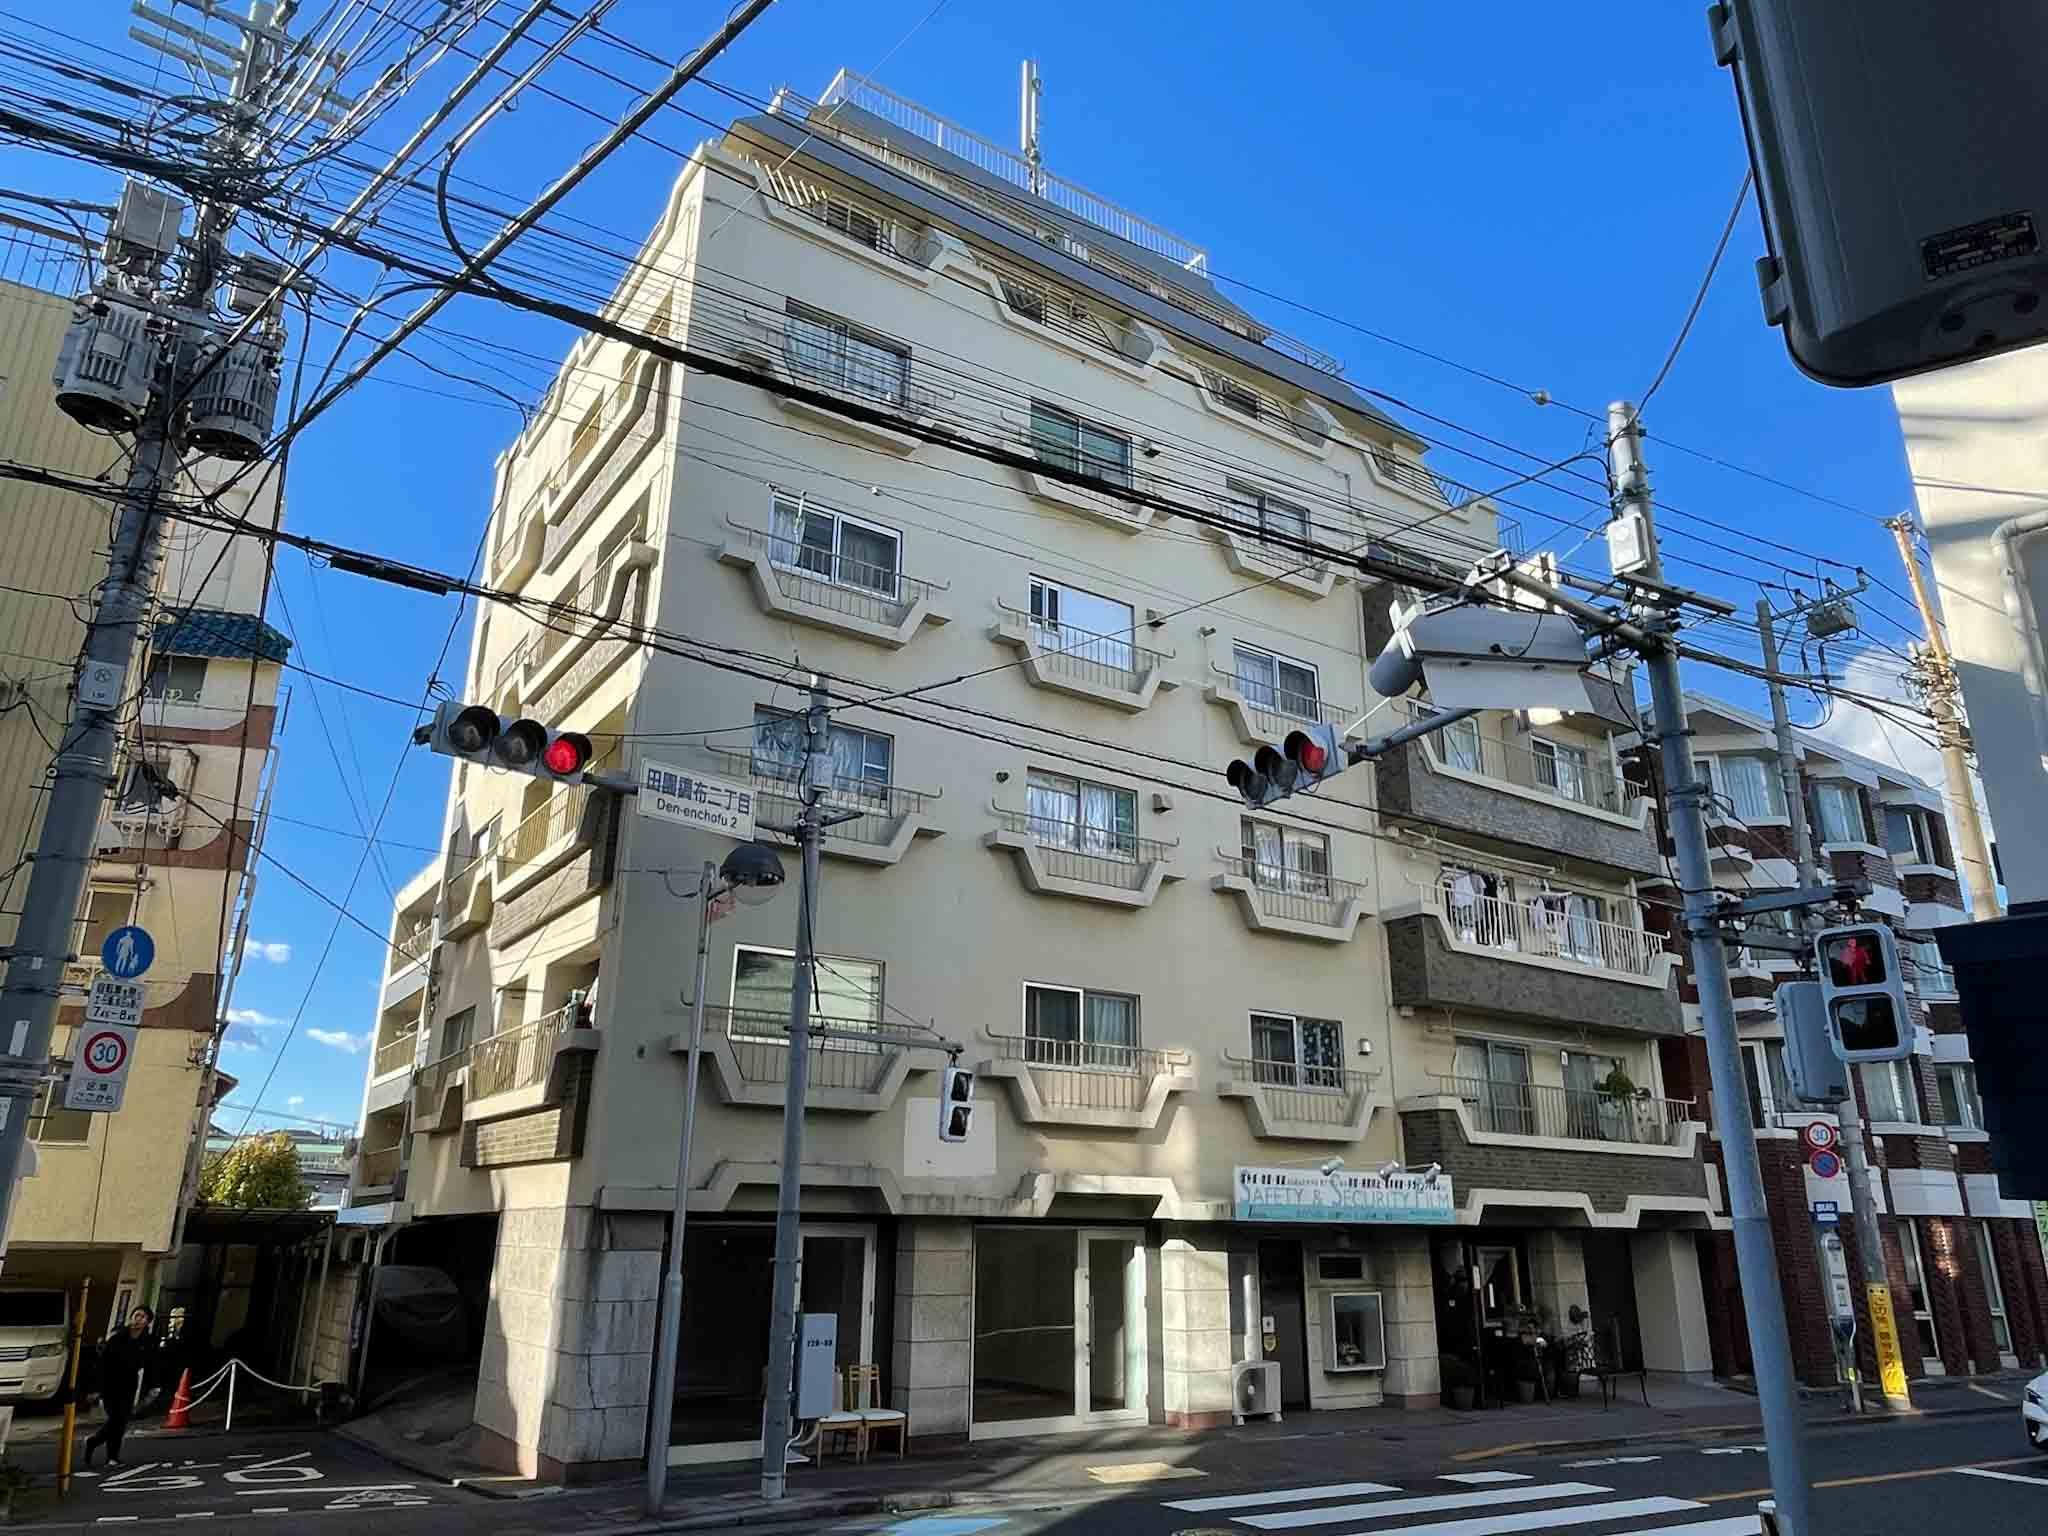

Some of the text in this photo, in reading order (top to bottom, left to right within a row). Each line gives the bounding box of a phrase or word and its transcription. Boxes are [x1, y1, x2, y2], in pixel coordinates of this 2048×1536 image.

[657, 798, 737, 828] Den-enchofu 2
[93, 1043, 118, 1063] 30
